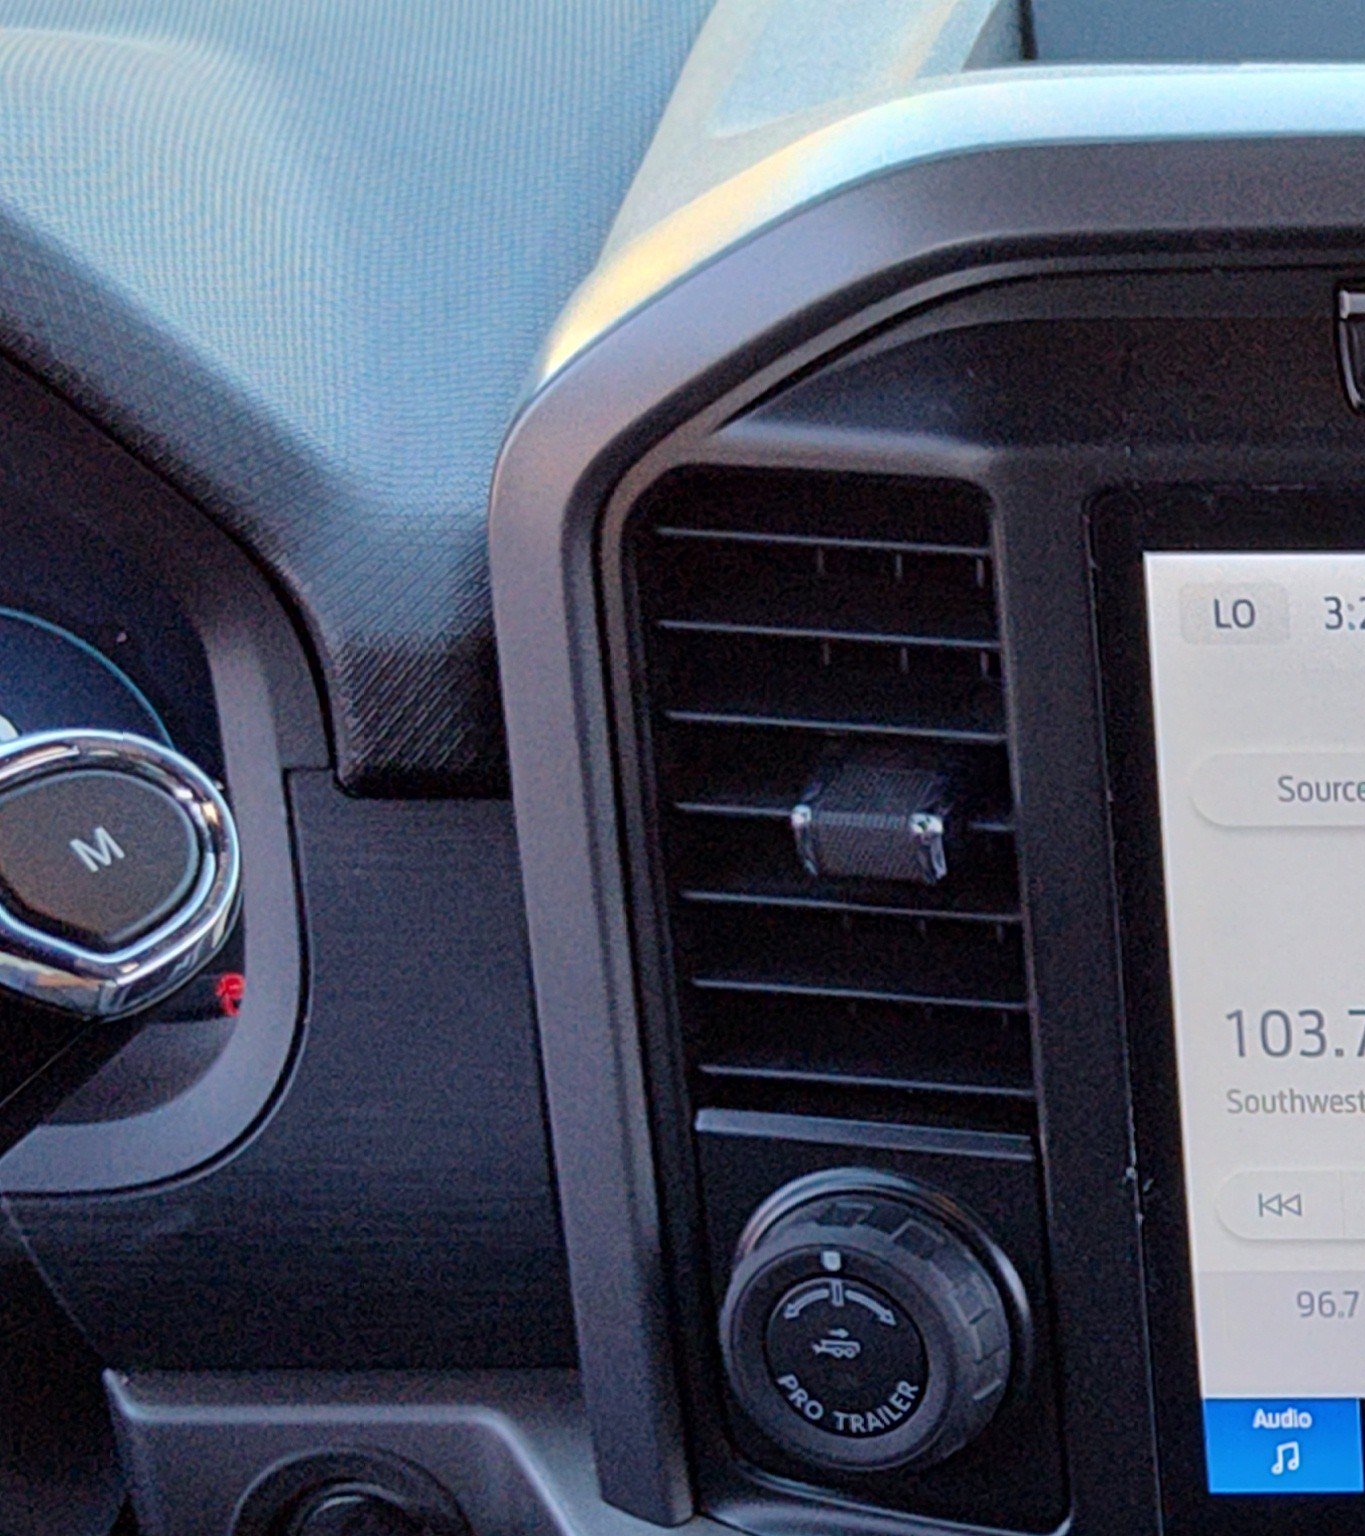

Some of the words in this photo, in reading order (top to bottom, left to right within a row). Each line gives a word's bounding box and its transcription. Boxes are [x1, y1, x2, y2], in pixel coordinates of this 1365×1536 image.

[1214, 598, 1256, 629] LO
[70, 826, 125, 874] M
[1296, 1291, 1361, 1319] 96.7
[778, 1374, 824, 1420] PRO
[833, 1380, 919, 1433] TRAILER
[1252, 1407, 1313, 1430] Audio
